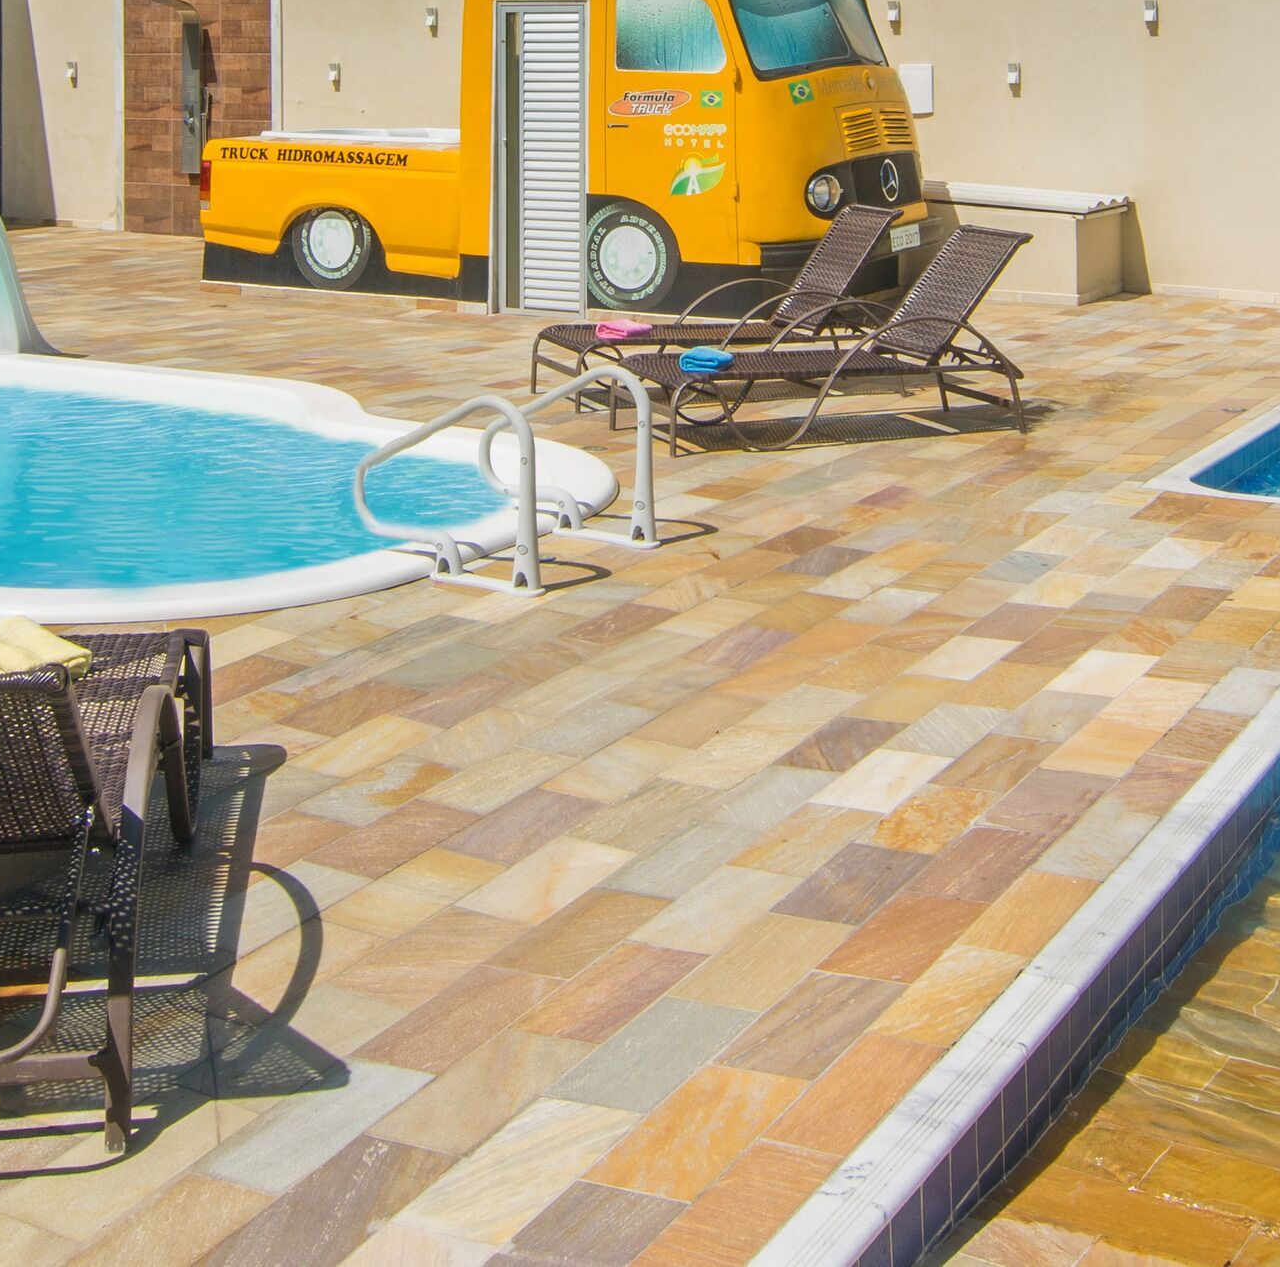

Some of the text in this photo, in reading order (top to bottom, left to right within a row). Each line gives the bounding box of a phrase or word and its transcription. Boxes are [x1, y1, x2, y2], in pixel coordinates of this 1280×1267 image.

[631, 104, 672, 115] TRUCK
[664, 138, 724, 148] HOTEL
[221, 147, 408, 167] TRUCK HIDROMASSAGEM
